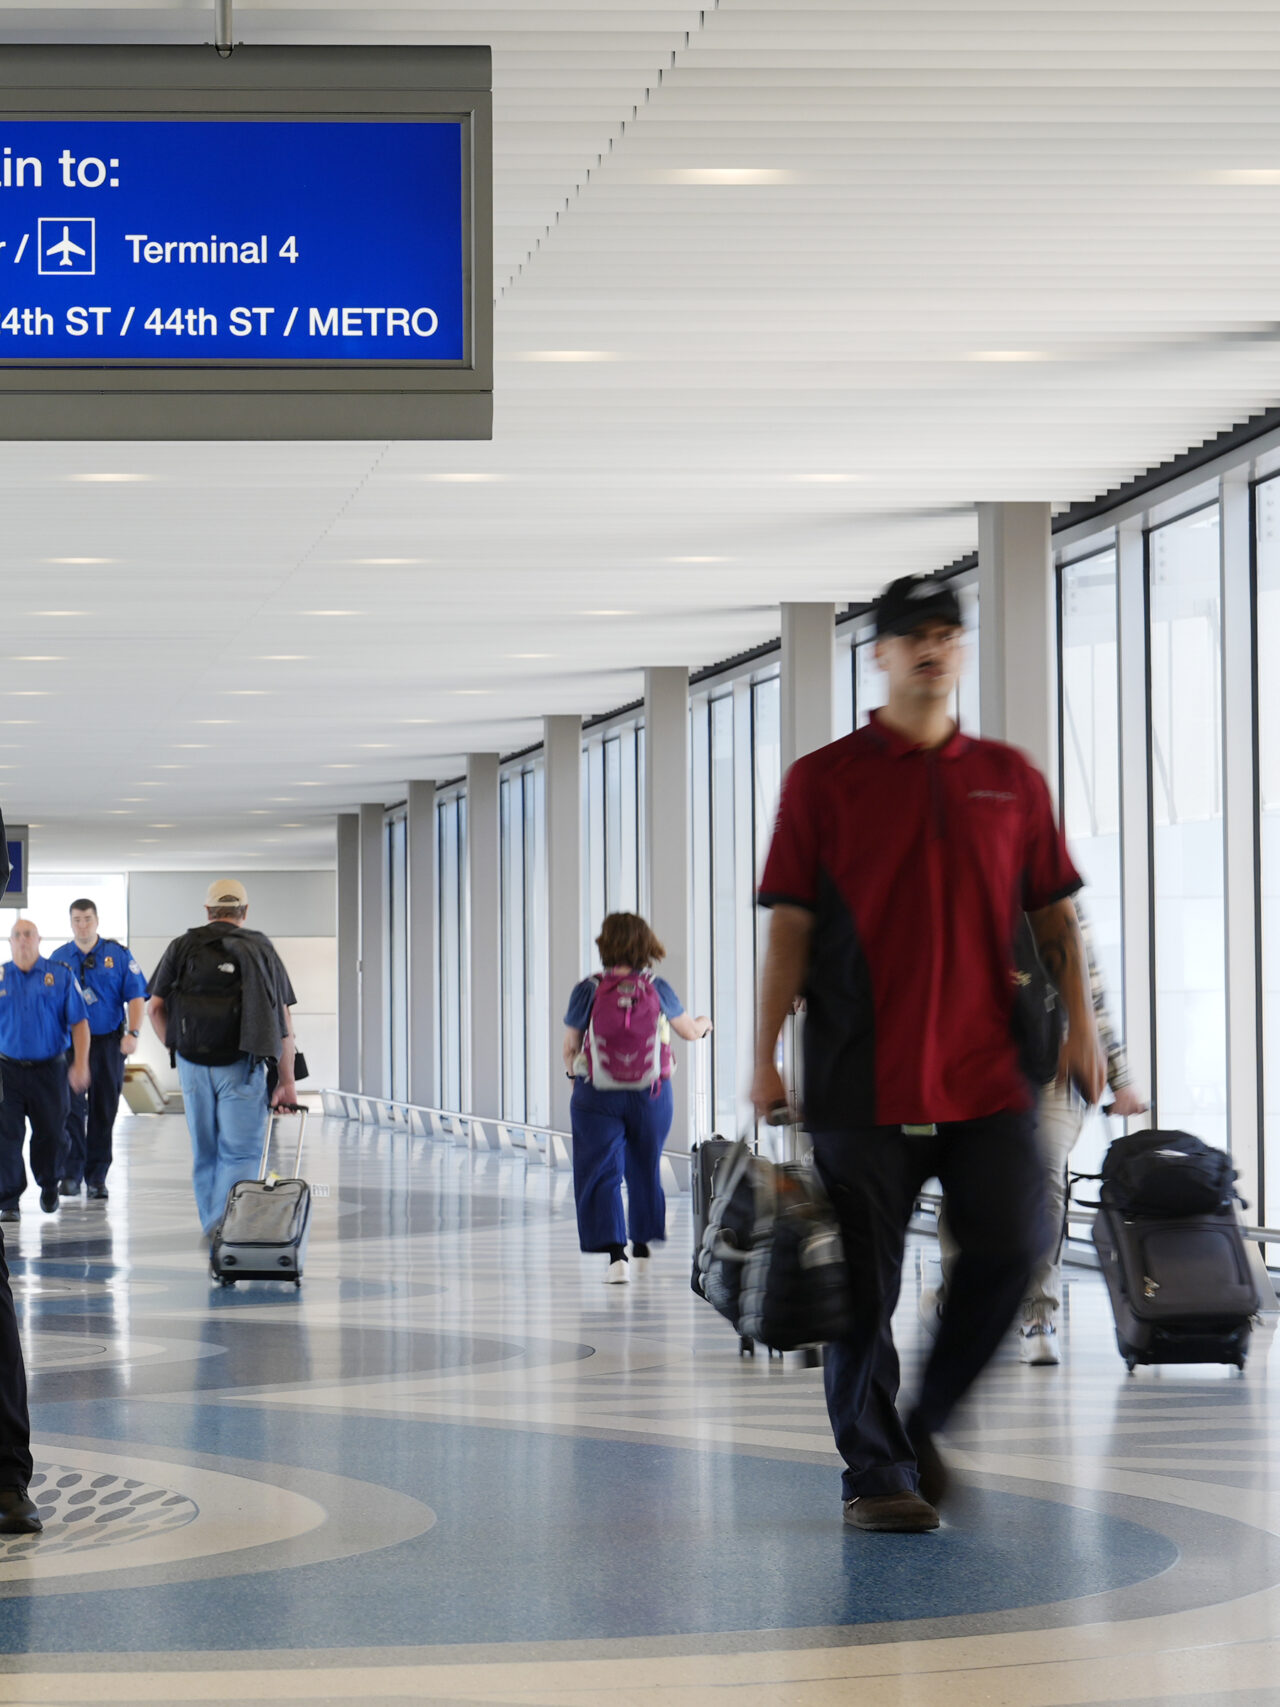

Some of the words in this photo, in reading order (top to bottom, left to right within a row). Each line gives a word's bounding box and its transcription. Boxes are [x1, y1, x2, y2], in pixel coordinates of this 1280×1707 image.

[58, 149, 119, 188] to:
[124, 234, 268, 264] Terminal
[278, 235, 299, 264] 4
[65, 306, 112, 337] ST
[144, 306, 218, 336] 44th
[229, 306, 275, 337] ST
[309, 307, 439, 337] METRO
